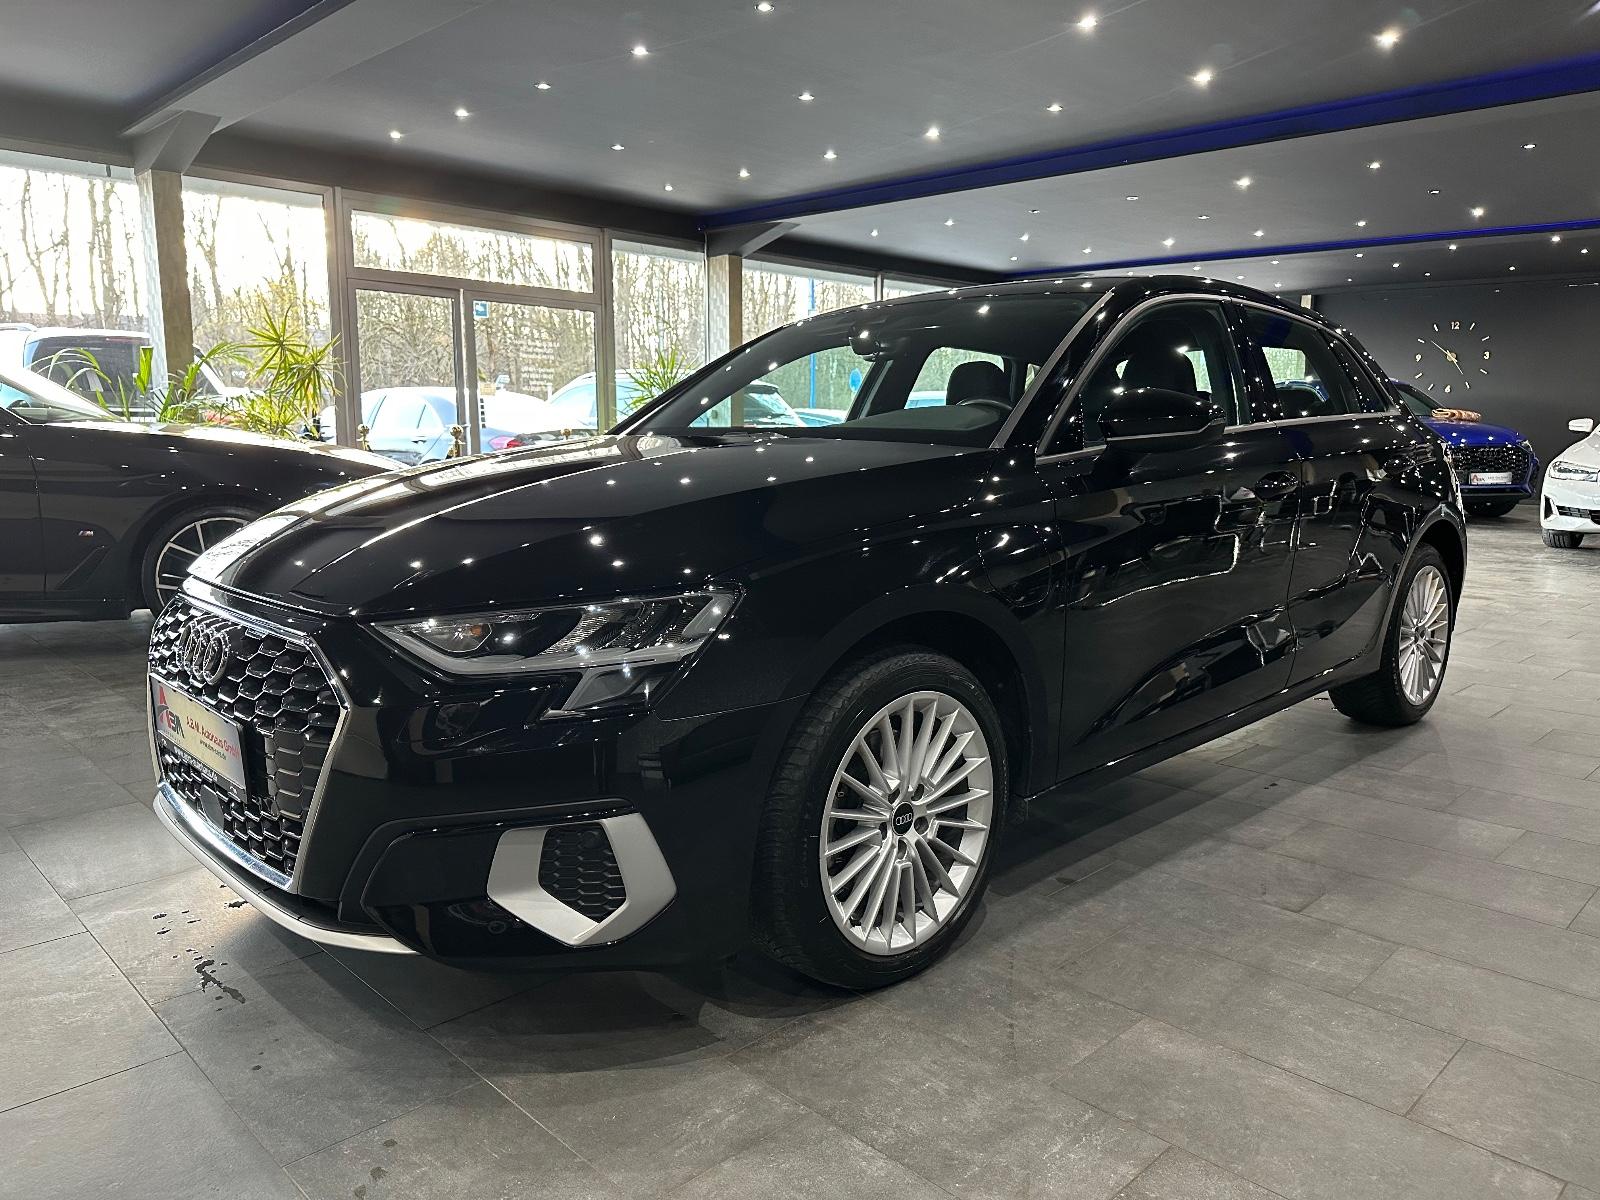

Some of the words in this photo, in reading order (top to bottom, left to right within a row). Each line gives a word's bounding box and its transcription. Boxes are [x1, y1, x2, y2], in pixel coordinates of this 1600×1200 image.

[1450, 321, 1460, 330] 12
[1415, 353, 1422, 362] 9
[1483, 351, 1490, 360] 3
[1444, 384, 1451, 393] 6
